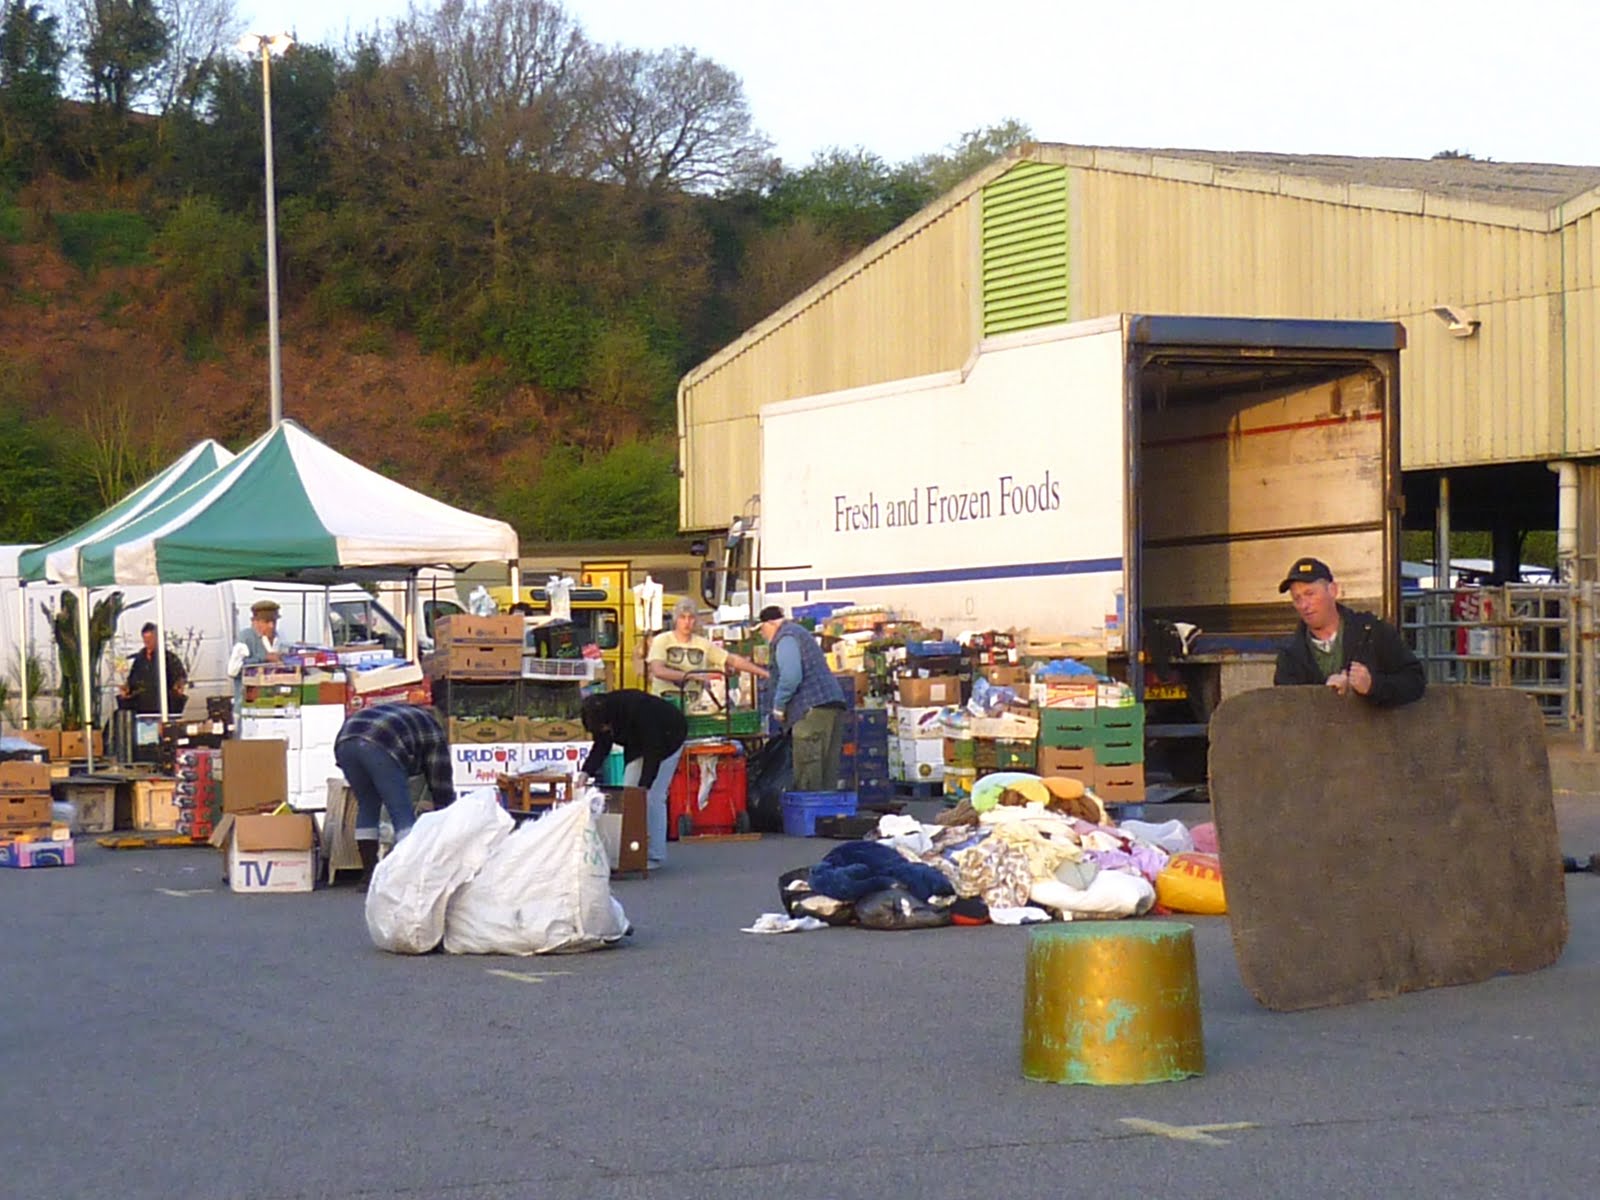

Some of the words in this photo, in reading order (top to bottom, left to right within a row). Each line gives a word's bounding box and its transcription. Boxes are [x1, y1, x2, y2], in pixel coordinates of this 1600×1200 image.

[834, 491, 880, 532] Fresh
[886, 487, 919, 528] and
[926, 485, 992, 525] Frozen
[998, 469, 1061, 517] Foods
[239, 861, 273, 887] TV
